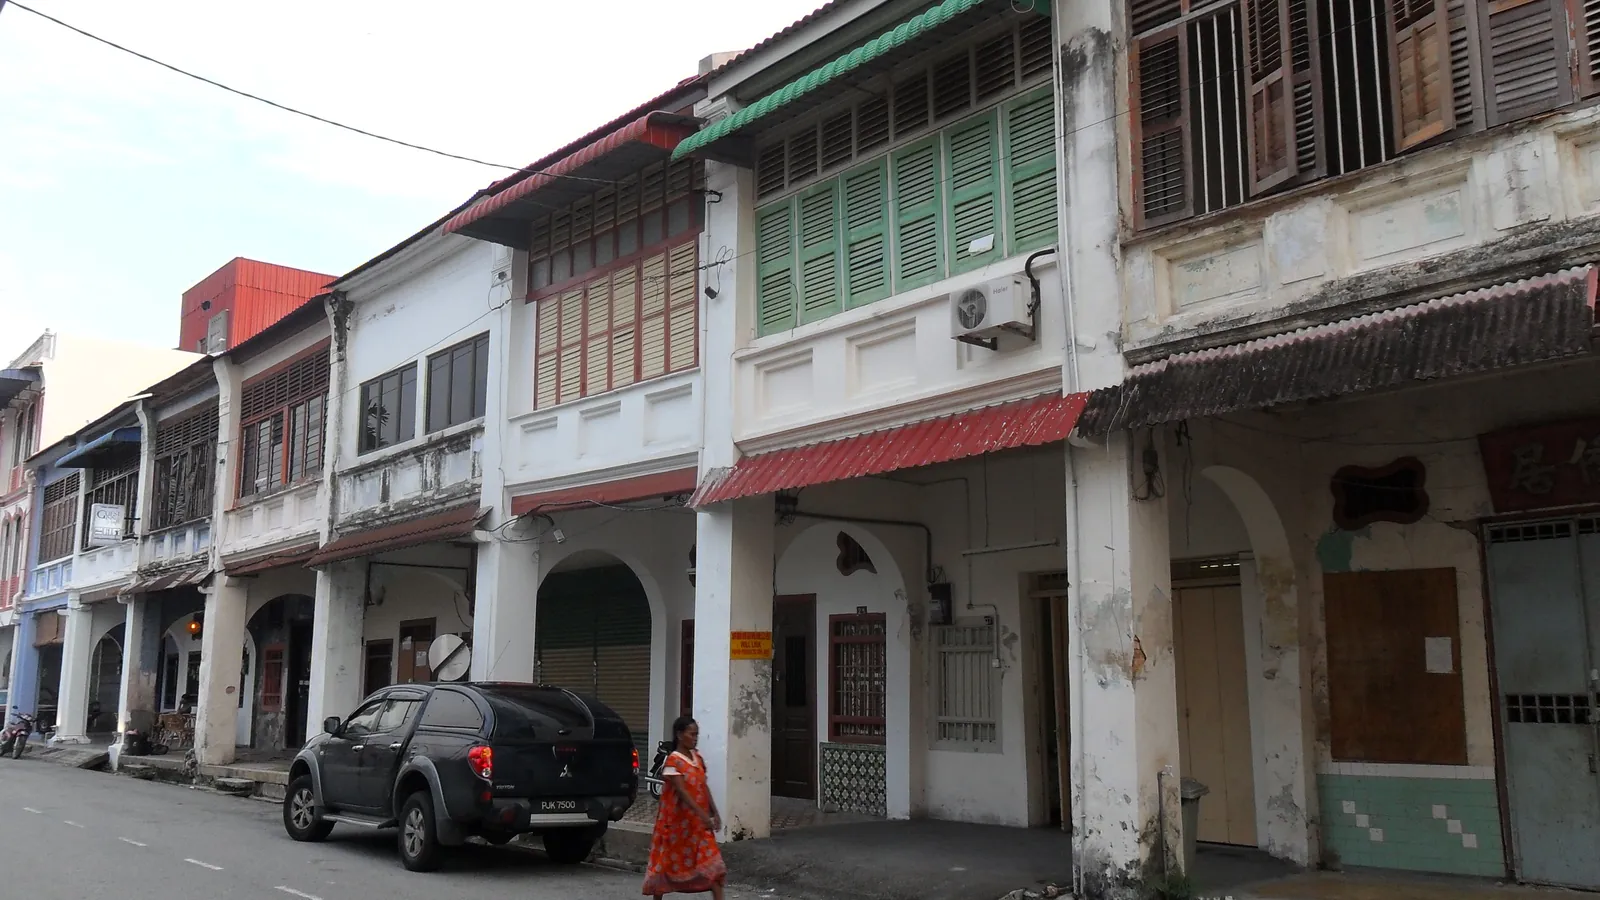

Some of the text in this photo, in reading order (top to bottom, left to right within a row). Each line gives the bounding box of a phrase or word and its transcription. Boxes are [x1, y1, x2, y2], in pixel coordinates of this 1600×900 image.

[993, 285, 1008, 294] Haier
[541, 800, 576, 810] PJK 7500
